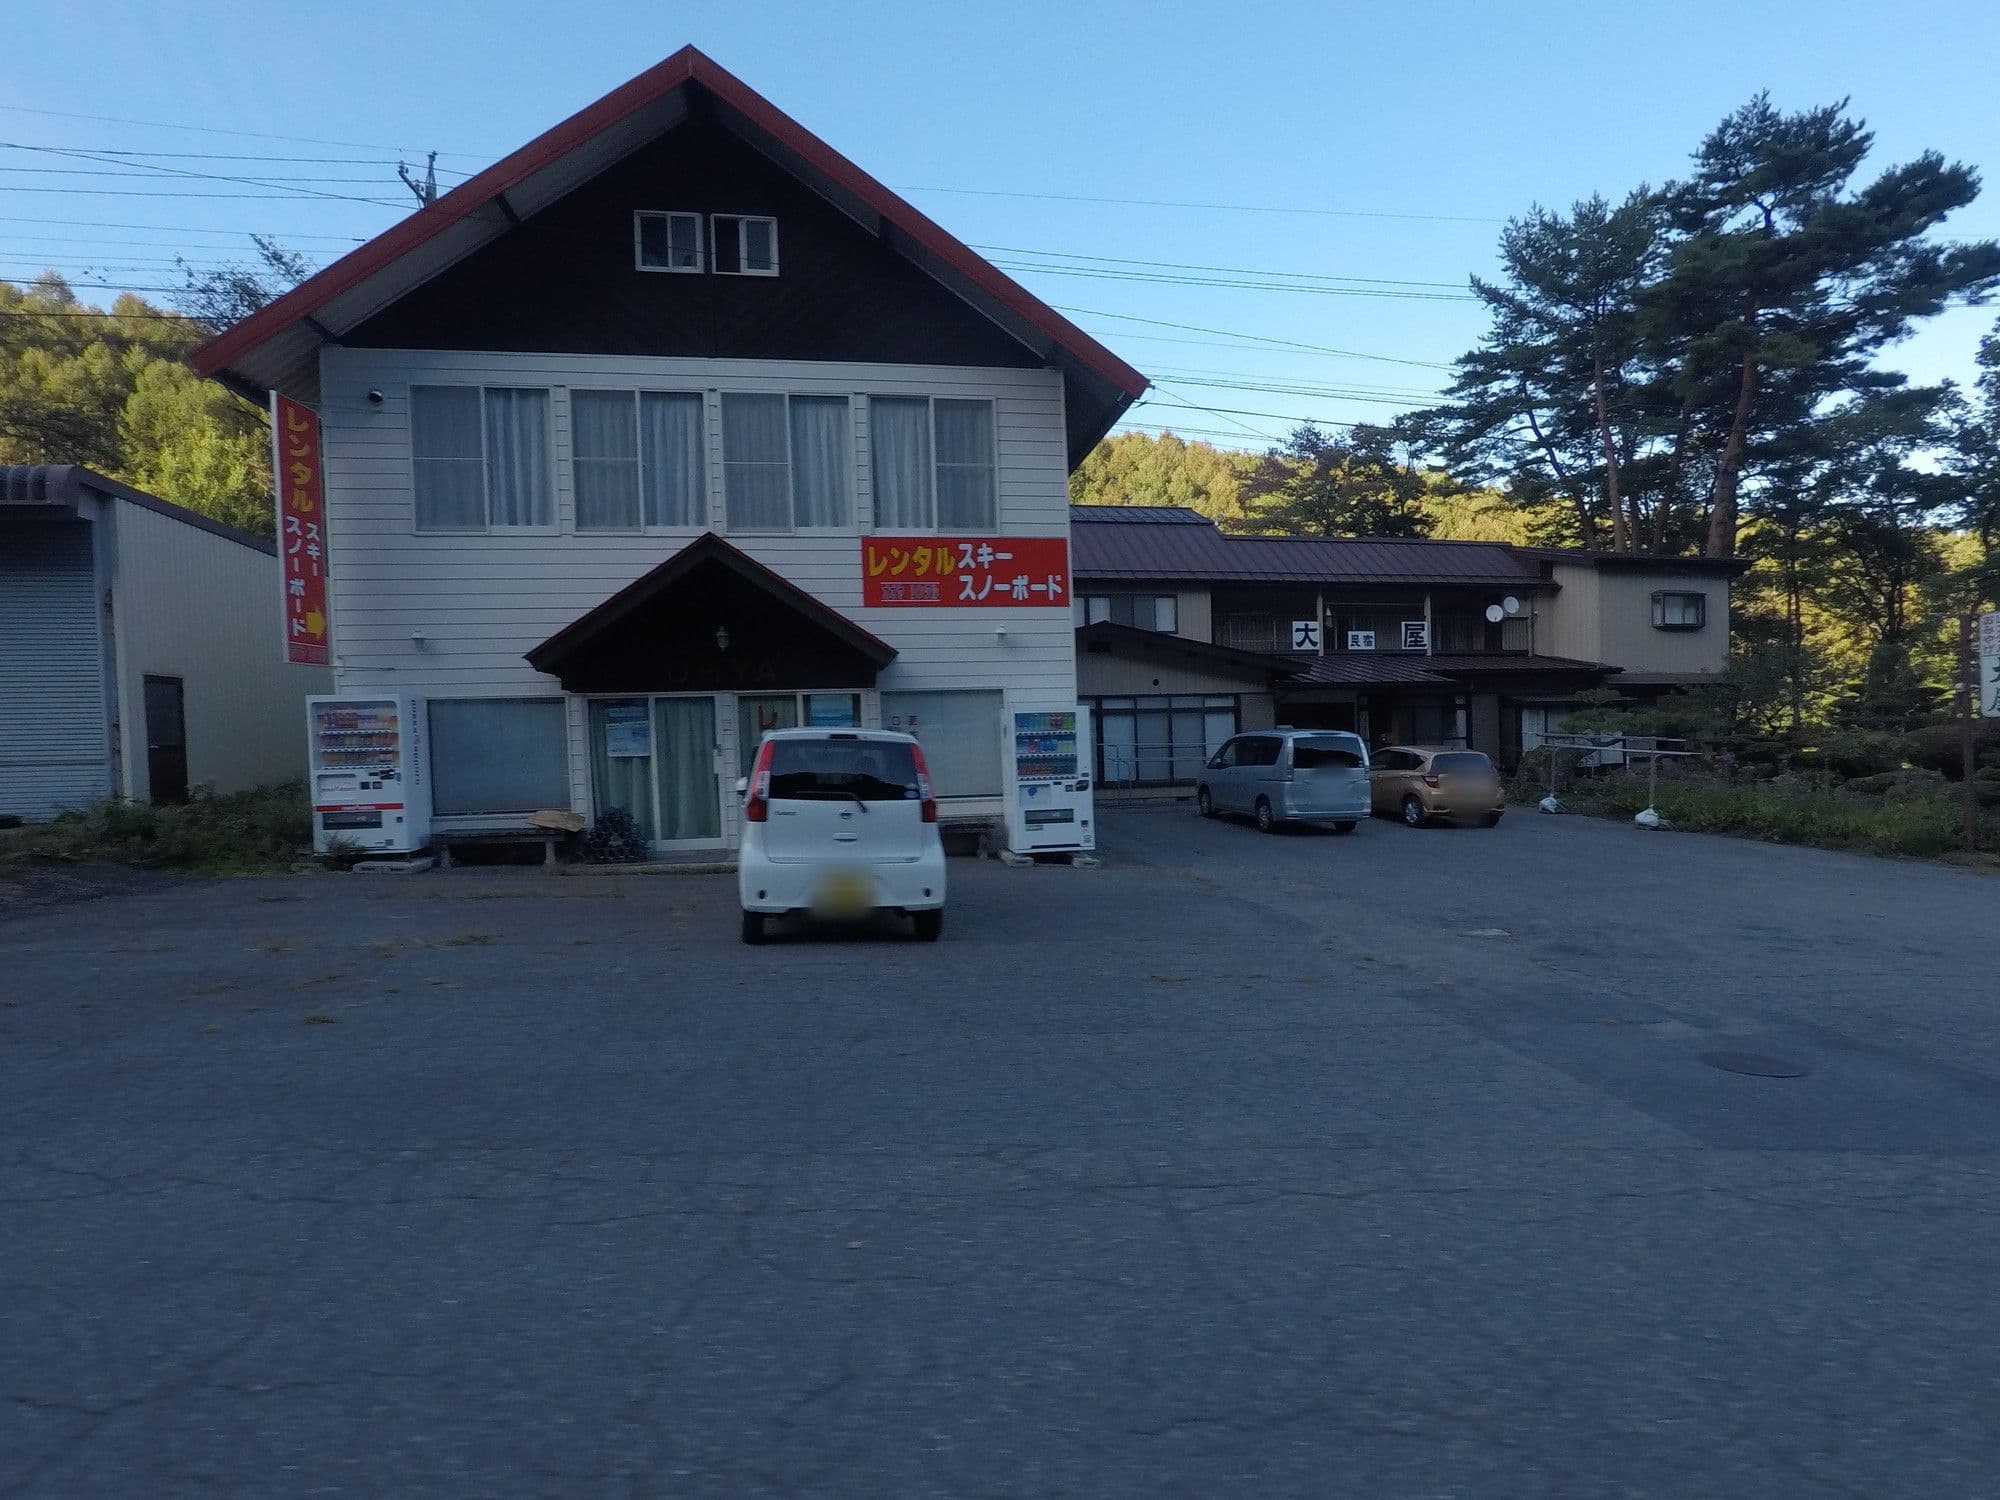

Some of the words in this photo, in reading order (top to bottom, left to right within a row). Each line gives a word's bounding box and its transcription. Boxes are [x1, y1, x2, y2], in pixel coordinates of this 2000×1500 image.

[286, 407, 313, 512] レンタル
[306, 522, 321, 576] スキー
[869, 546, 957, 576] レンタル
[958, 543, 1013, 569] スキー
[286, 516, 306, 636] スノーボード
[958, 574, 1062, 601] スノーボード
[1295, 623, 1318, 648] 大
[1351, 634, 1373, 647] 民宿
[1404, 623, 1427, 648] 屋
